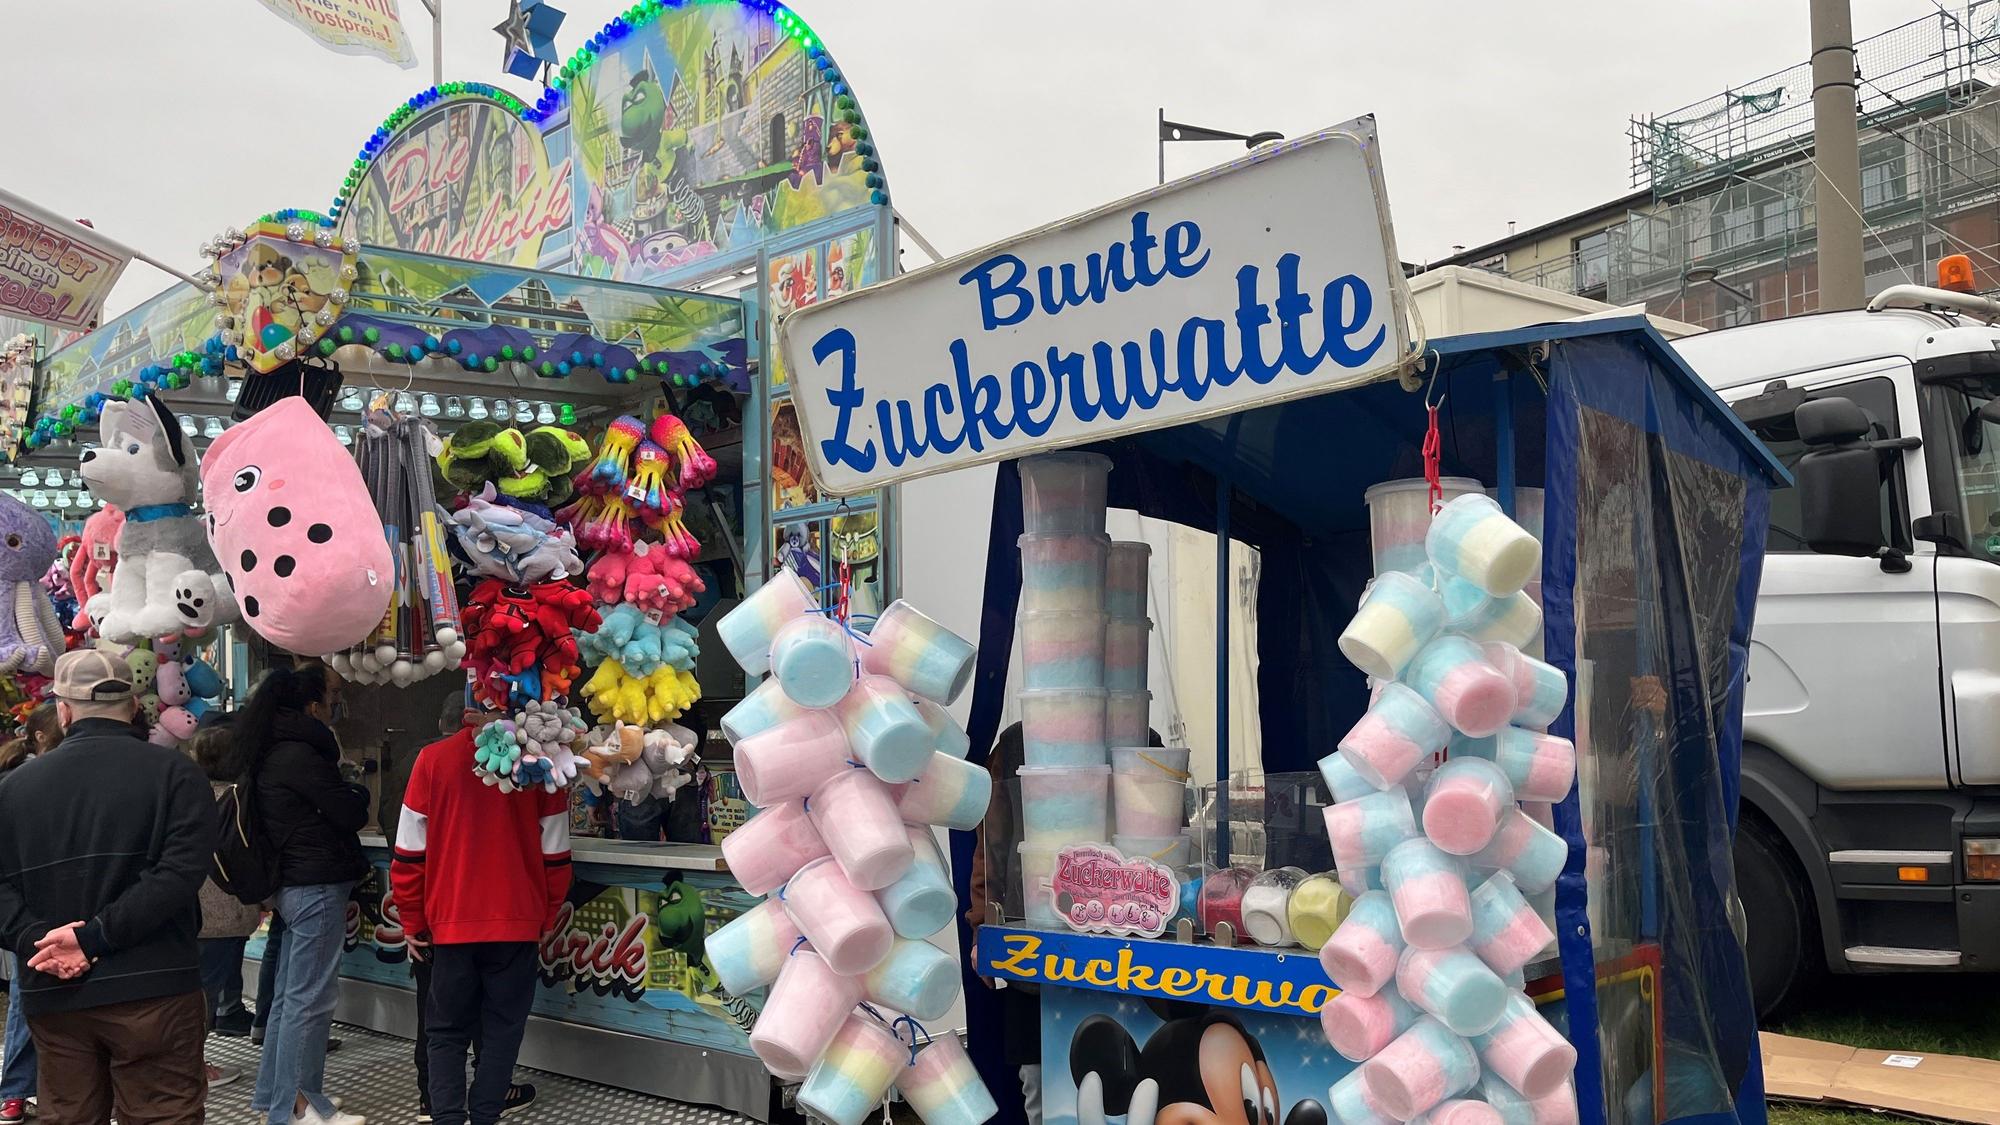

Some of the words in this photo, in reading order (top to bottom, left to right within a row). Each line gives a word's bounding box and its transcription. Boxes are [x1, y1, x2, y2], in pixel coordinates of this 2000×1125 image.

[347, 9, 374, 25] ein
[387, 137, 469, 213] Die
[959, 211, 1211, 334] Bunte
[811, 253, 1386, 473] Zuckerwatte
[1058, 854, 1171, 899] Zuckerwatte
